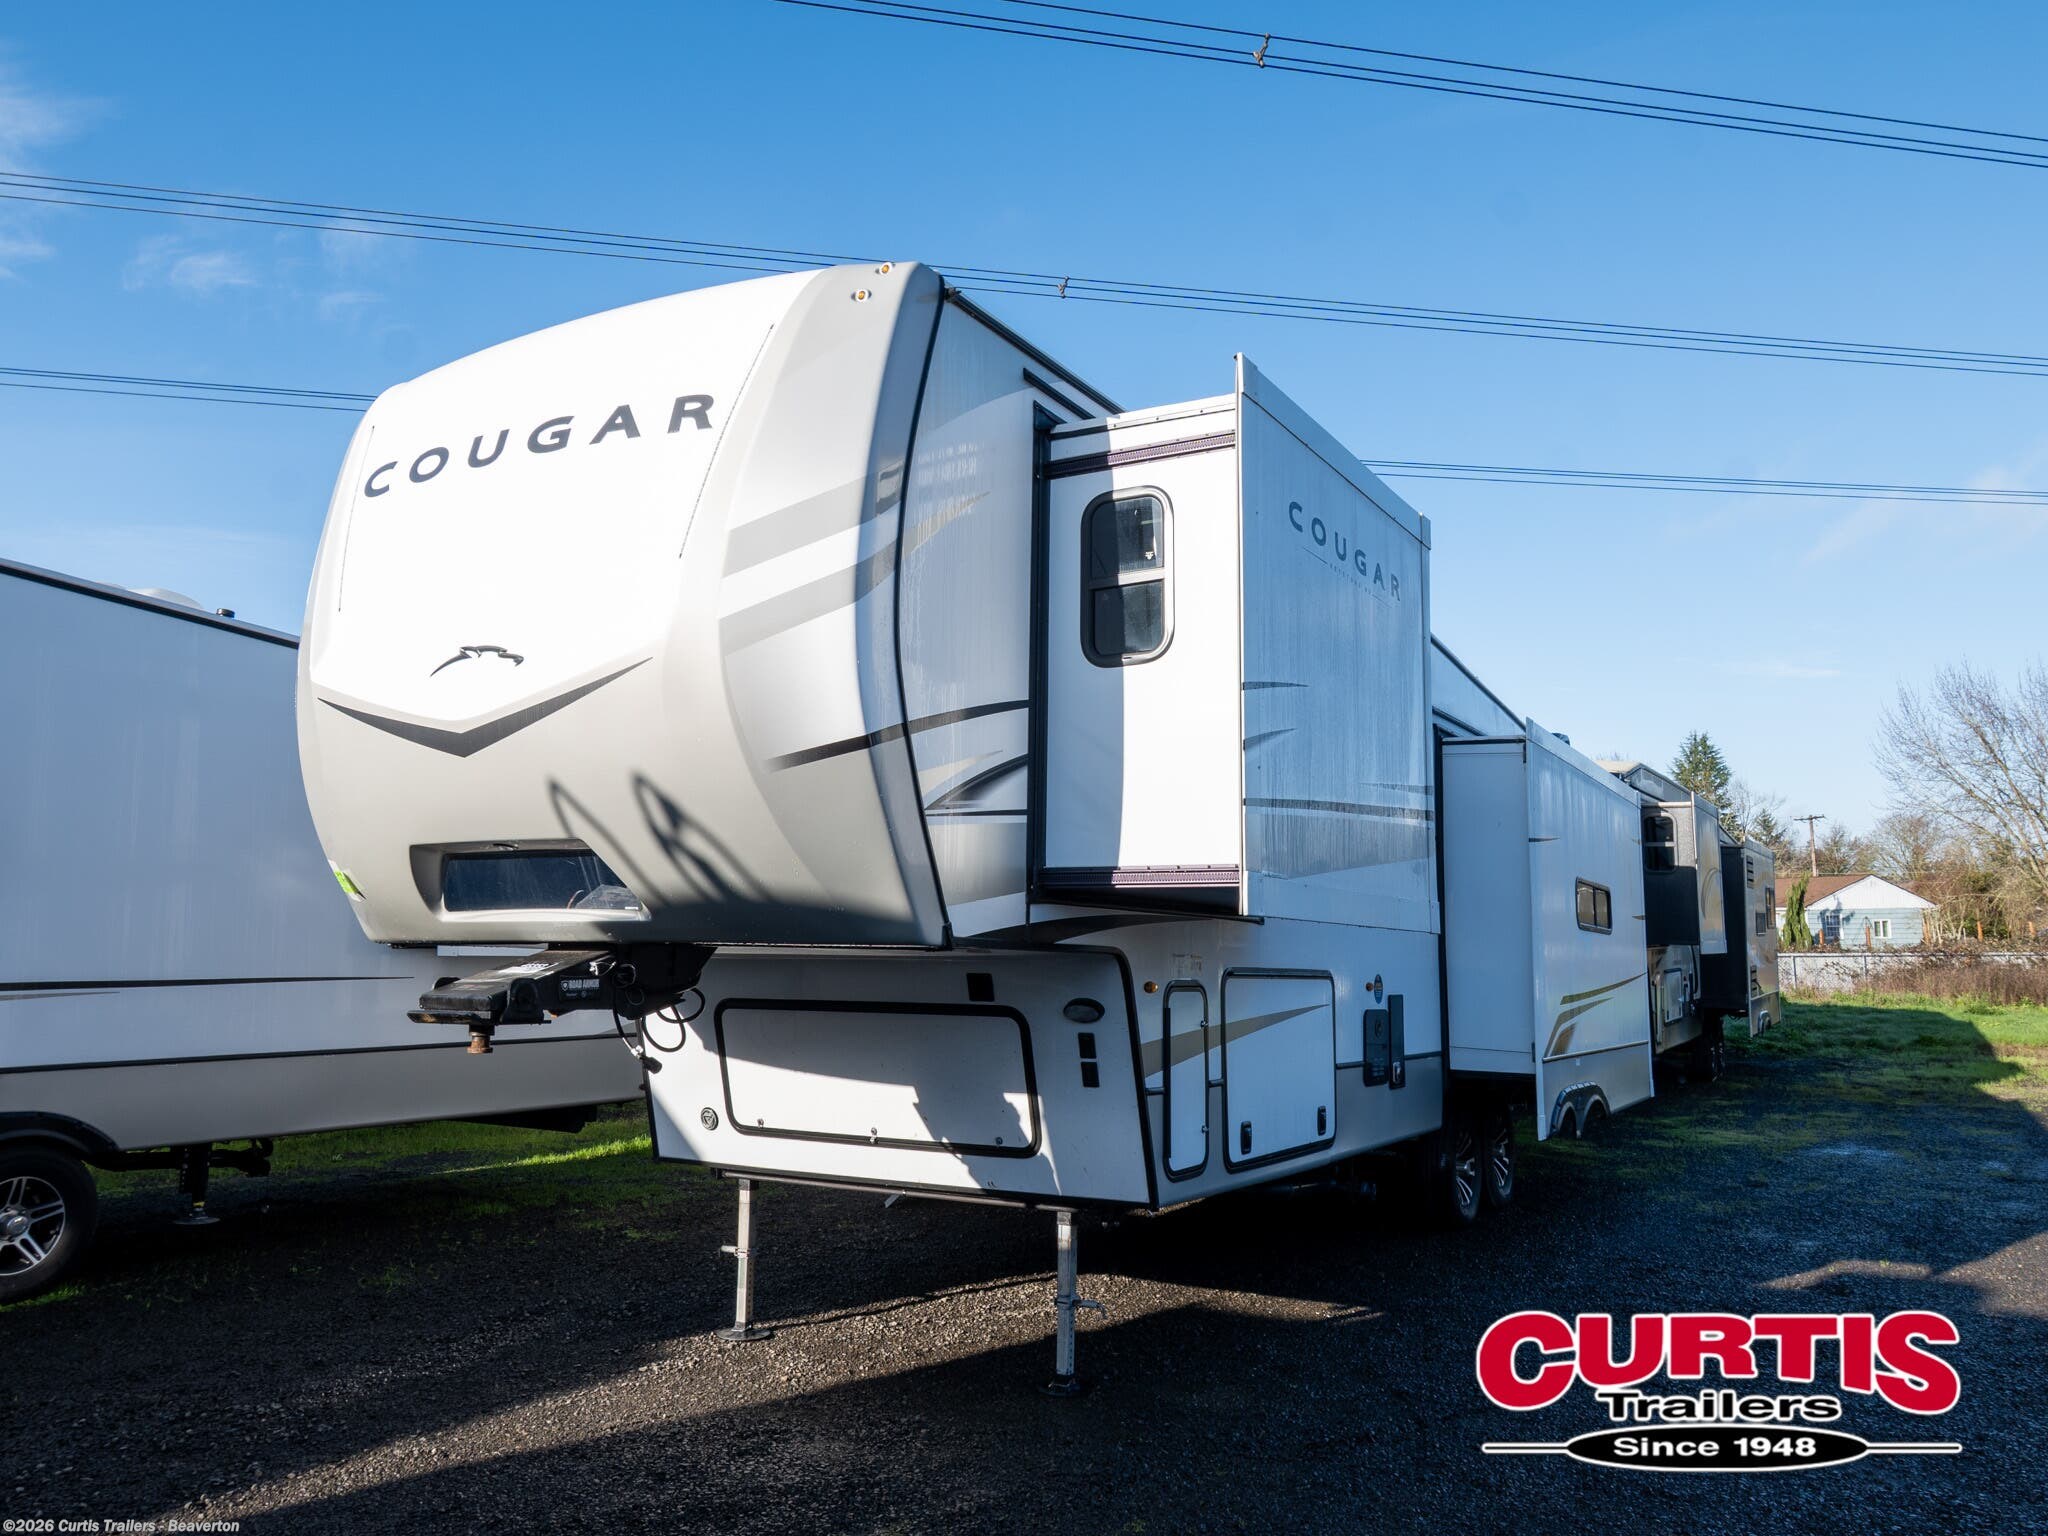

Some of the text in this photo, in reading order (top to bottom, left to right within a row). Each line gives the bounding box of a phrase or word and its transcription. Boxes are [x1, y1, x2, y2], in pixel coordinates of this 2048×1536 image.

[364, 393, 715, 498] COUGAR
[1288, 501, 1401, 601] COUGAR
[569, 979, 582, 989] ROAD
